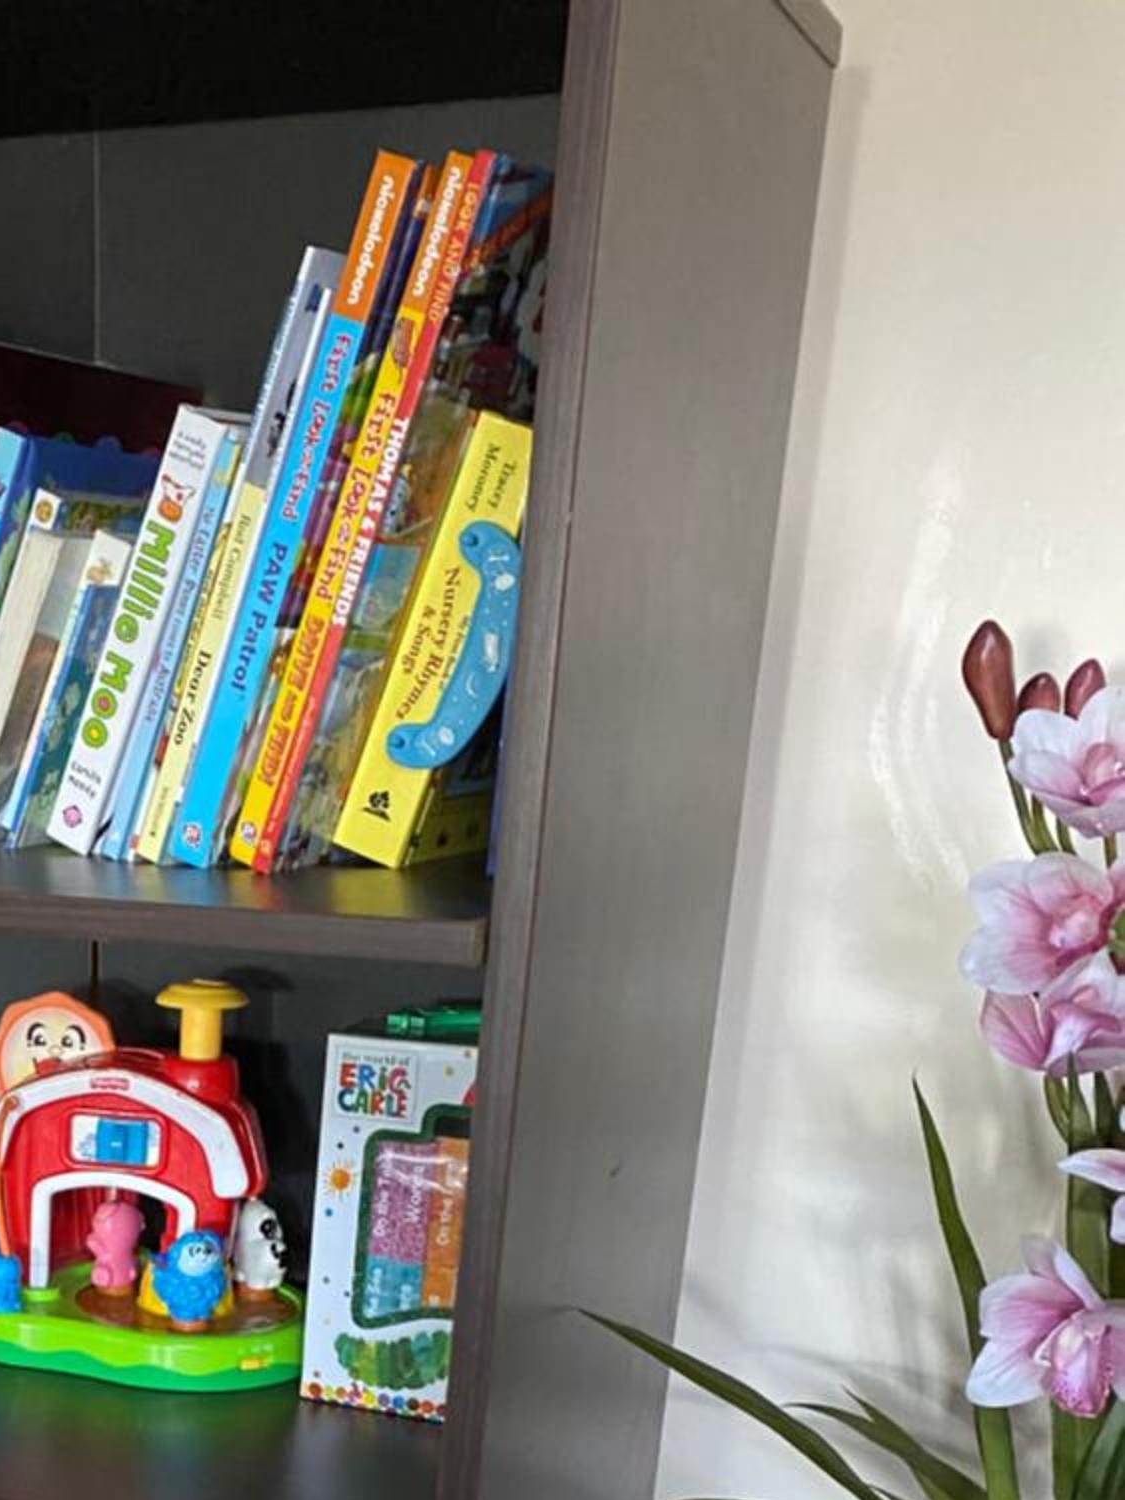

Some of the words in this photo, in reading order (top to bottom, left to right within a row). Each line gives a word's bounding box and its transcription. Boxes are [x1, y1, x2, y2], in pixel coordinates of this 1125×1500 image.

[454, 180, 480, 229] LOOK
[347, 174, 394, 306] nickelodeon
[441, 238, 463, 276] AND
[429, 282, 452, 322] FIND
[367, 416, 411, 516] THOMAS
[465, 442, 500, 511] Moroney
[487, 456, 516, 510] Tracey
[361, 517, 376, 531] &
[114, 519, 175, 643] Millie
[210, 547, 241, 620] Campbell
[258, 541, 288, 605] PAW
[332, 532, 373, 628] FRIENDS
[422, 605, 438, 619] &
[436, 567, 461, 648] Nursery
[188, 650, 211, 701] Dear
[231, 611, 267, 690] Patrol
[402, 620, 432, 674] Songs
[81, 651, 134, 749] Moo
[396, 655, 444, 721] Rhymes
[174, 707, 195, 745] Zoo
[338, 1088, 408, 1118] CARLE
